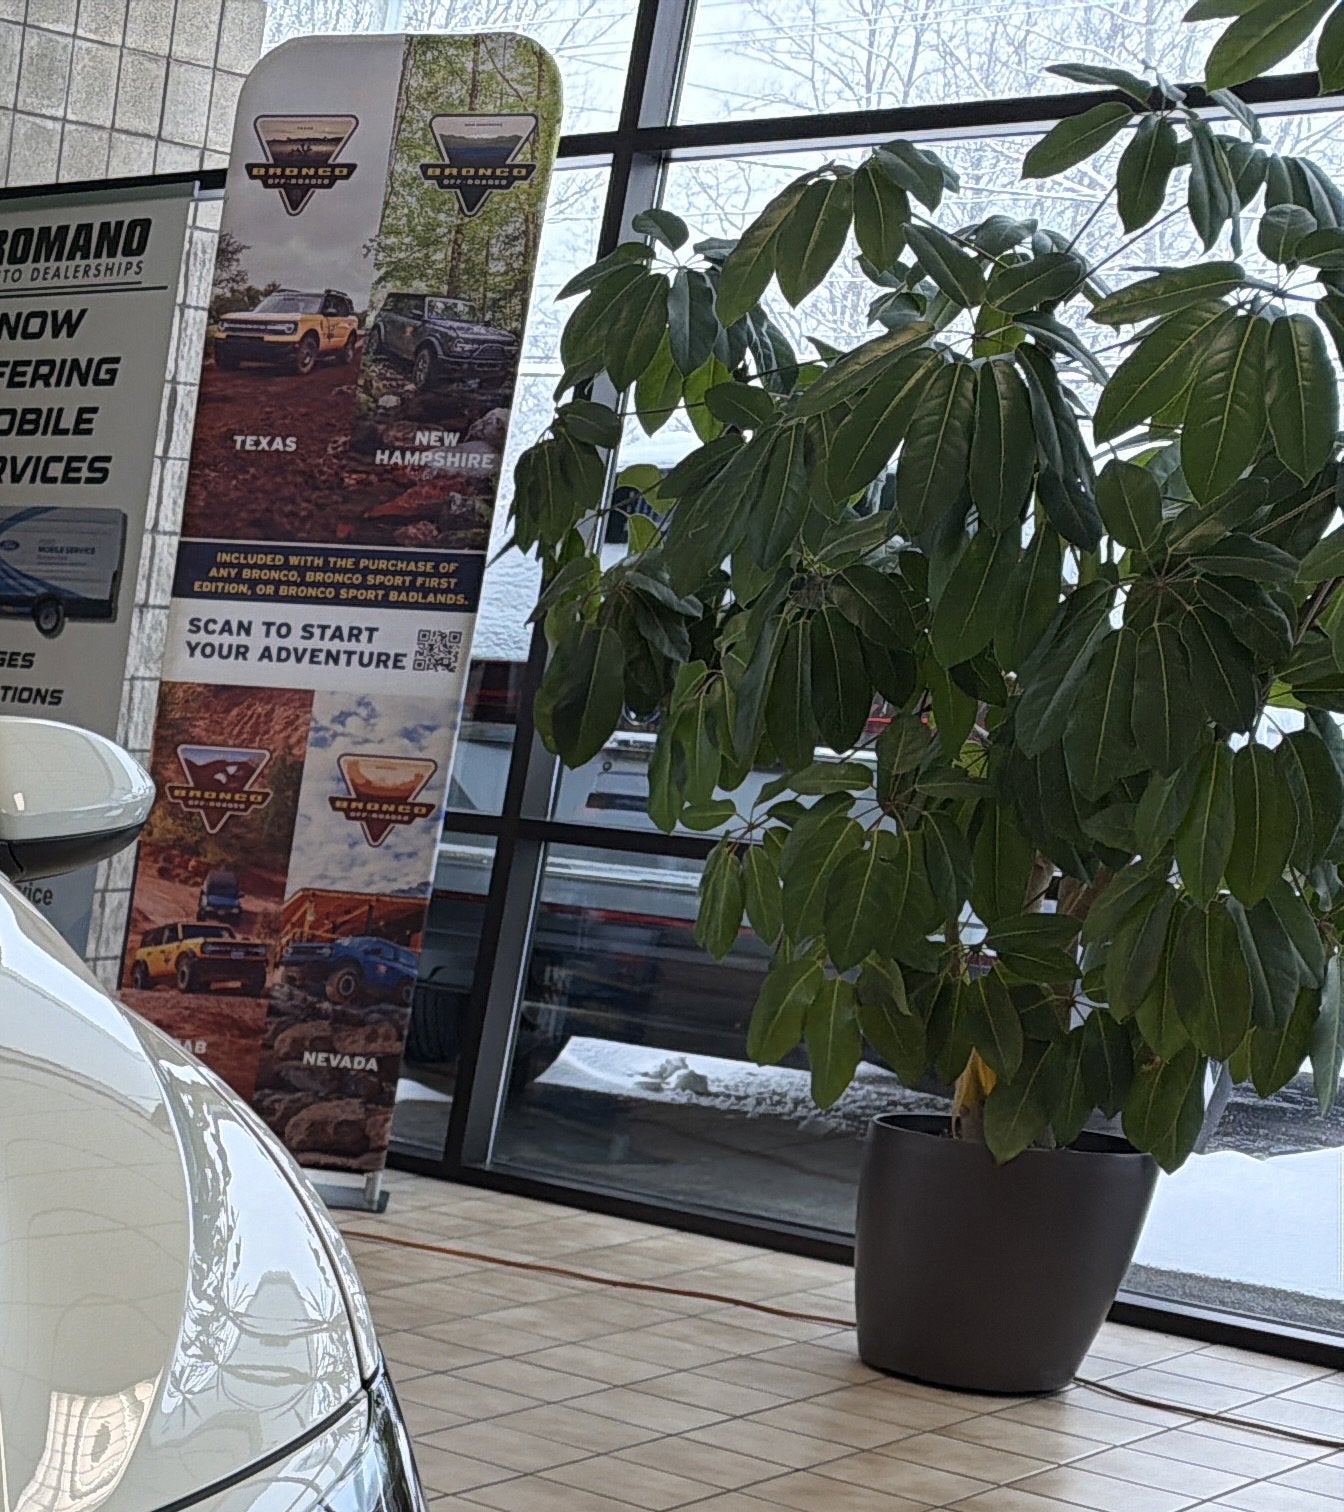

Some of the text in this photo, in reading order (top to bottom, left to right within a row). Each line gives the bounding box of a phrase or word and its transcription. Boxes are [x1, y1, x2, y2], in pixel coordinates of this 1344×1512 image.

[251, 167, 351, 177] BRONCO
[426, 167, 528, 177] BRONCO
[30, 259, 144, 282] DEALERSHIPS
[233, 435, 298, 452] TEXAS
[414, 430, 461, 446] NEW
[374, 449, 495, 469] HAMPSHIRE
[216, 551, 459, 574] INCLUDED WITH THE PURCHASE OF
[208, 567, 458, 590] ANY BRONCO, BRONCO SPORT FIRST
[193, 581, 470, 606] EDITION, OR BRONCO SPORT BADLANDS.
[188, 616, 380, 645] SCAN TO START
[185, 640, 408, 671] YOUR ADVENTURE
[173, 788, 264, 802] BRONCO
[334, 799, 428, 814] BRONCO
[302, 1049, 379, 1073] NEVADA
